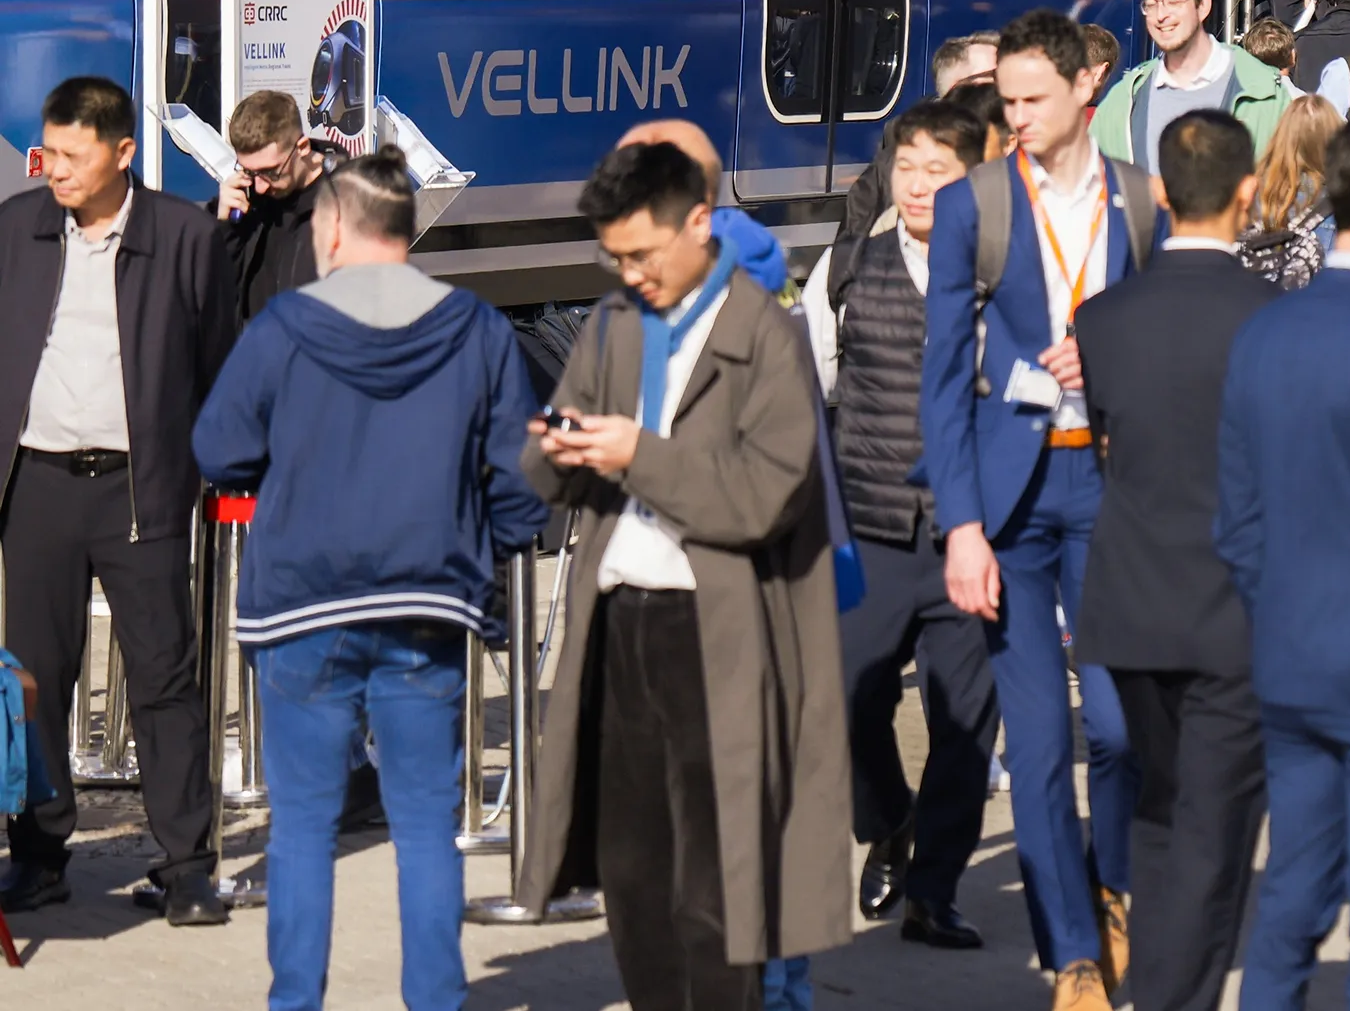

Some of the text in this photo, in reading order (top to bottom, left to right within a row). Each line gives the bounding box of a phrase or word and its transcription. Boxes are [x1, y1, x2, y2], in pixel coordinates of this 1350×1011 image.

[258, 5, 288, 22] CRRC
[244, 42, 286, 60] VELLINK
[437, 44, 691, 118] VELLINK
